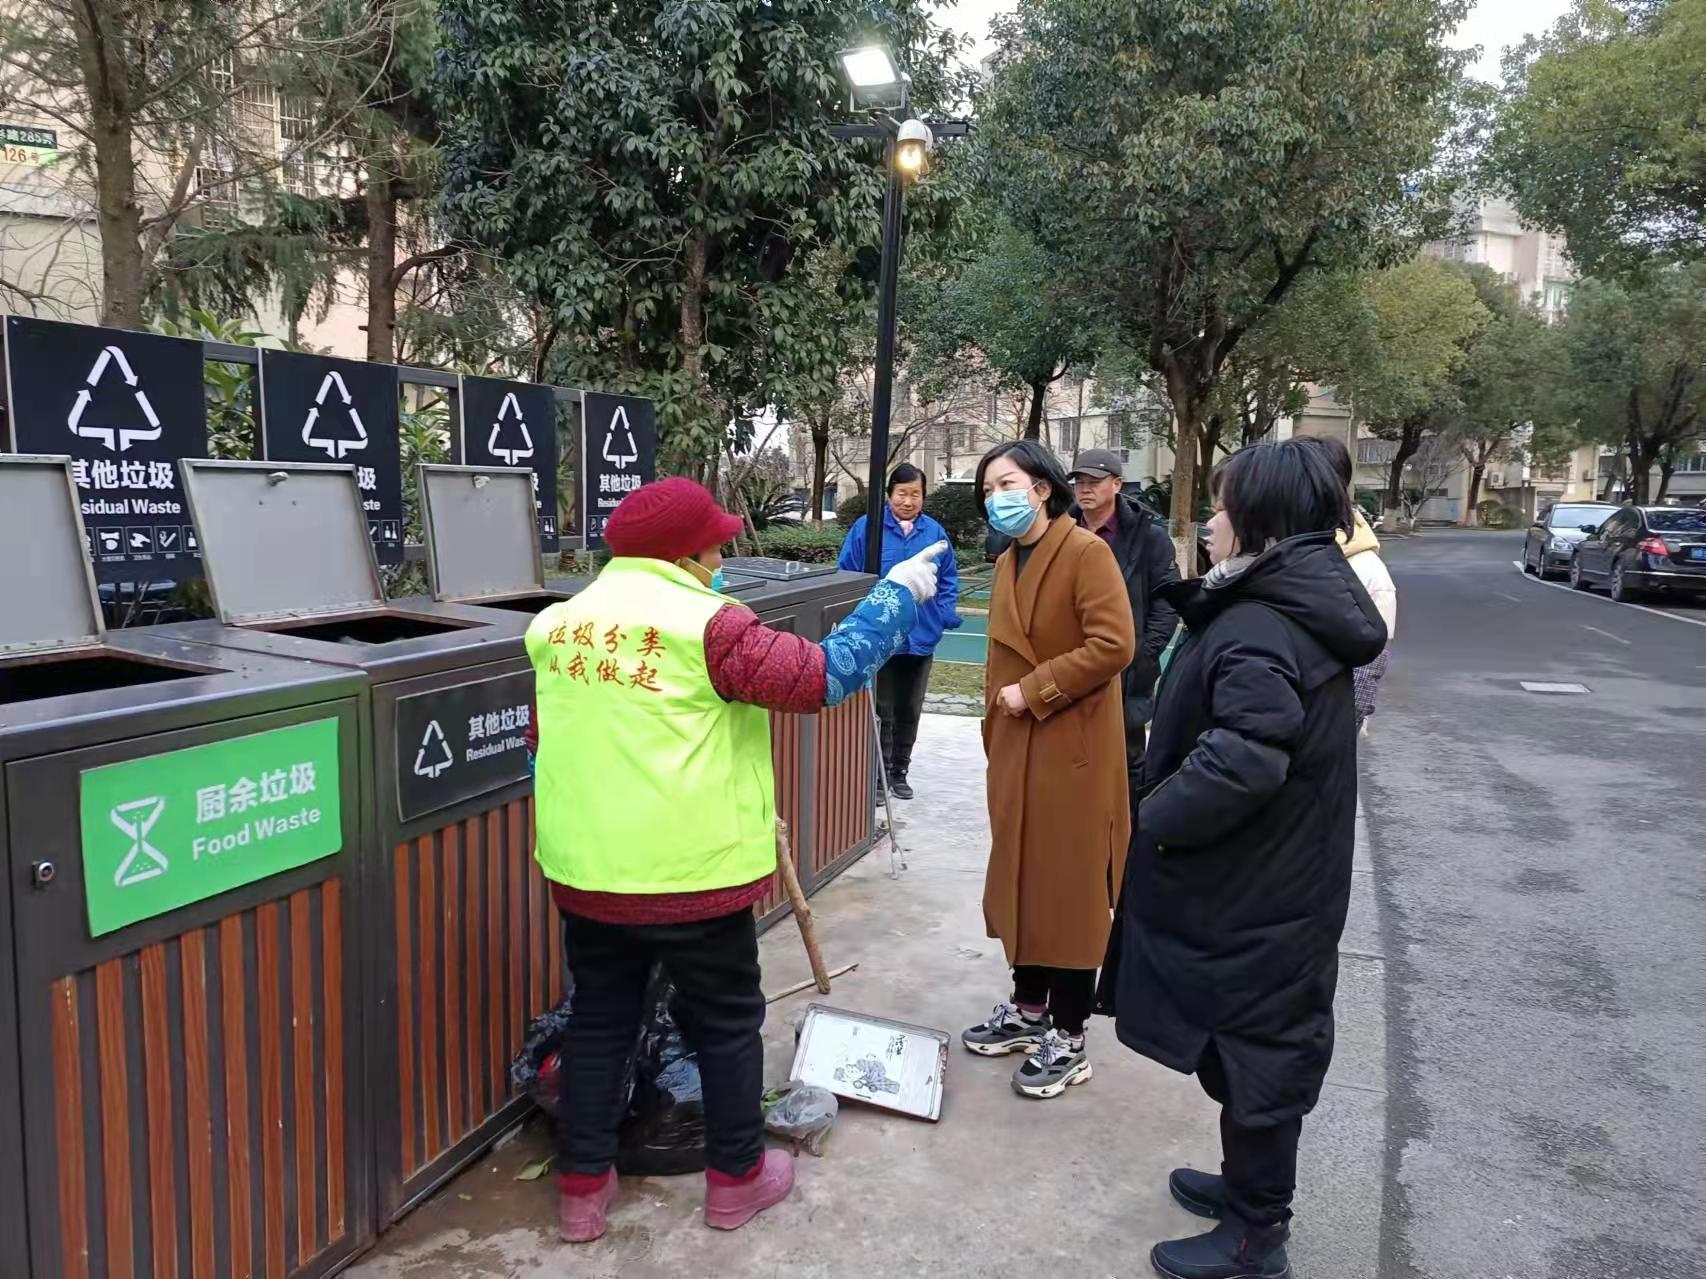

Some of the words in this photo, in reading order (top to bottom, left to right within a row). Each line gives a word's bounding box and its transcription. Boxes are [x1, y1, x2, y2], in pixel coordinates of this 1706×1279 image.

[71, 459, 175, 489] 其他垃圾
[599, 473, 642, 493] 其他垃圾
[81, 499, 129, 515] sidual
[131, 499, 181, 515] Waste
[363, 499, 381, 511] ste
[548, 621, 668, 658] 垃圾分类
[549, 651, 664, 692] 从我做起
[468, 704, 530, 741] 其他垃圾
[466, 739, 505, 762] Residual
[505, 736, 527, 750] Was
[196, 761, 316, 823] 厨余垃圾
[192, 824, 250, 860] Food
[255, 806, 321, 840] Waste
